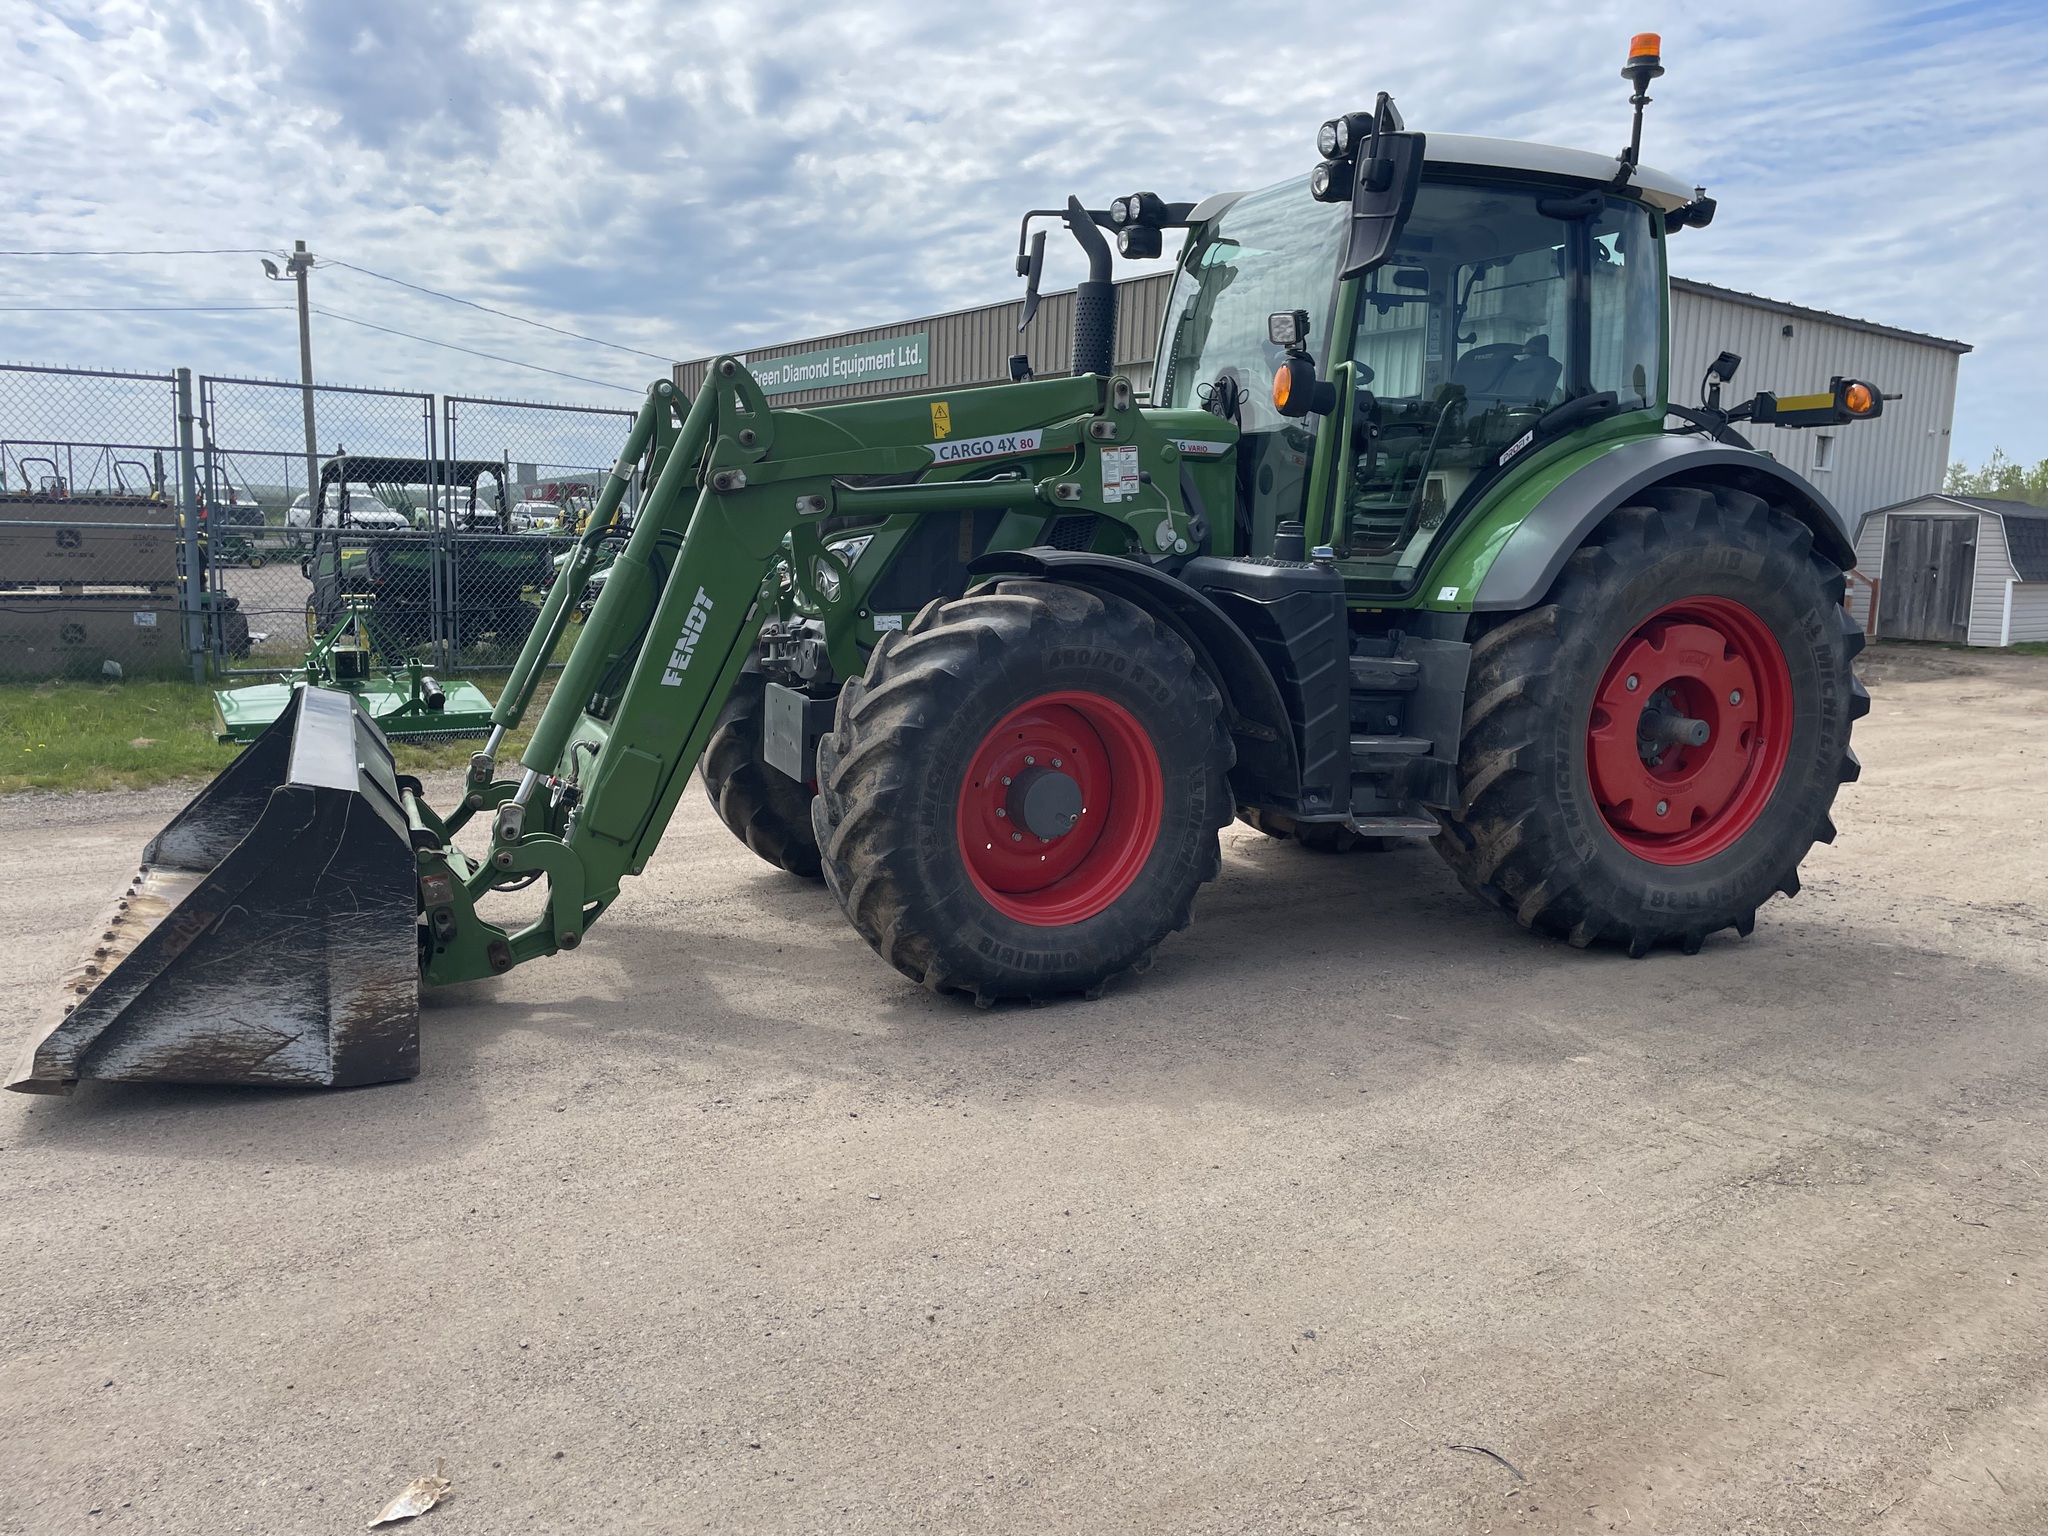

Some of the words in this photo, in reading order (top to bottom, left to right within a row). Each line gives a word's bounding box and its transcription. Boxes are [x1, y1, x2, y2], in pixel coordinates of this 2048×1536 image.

[752, 370, 780, 387] Green
[783, 357, 830, 383] Diamond
[833, 348, 895, 379] Equipment
[899, 343, 922, 366] Ltd.
[940, 440, 994, 460] CARGO
[998, 437, 1017, 452] 4X
[1020, 438, 1034, 449] 80
[660, 586, 714, 686] FENDT
[1049, 649, 1127, 673] 480/70
[1130, 662, 1146, 683] R
[1146, 677, 1171, 704] 28
[1650, 889, 1678, 911] 38
[977, 936, 1079, 972] OMNIBIB
